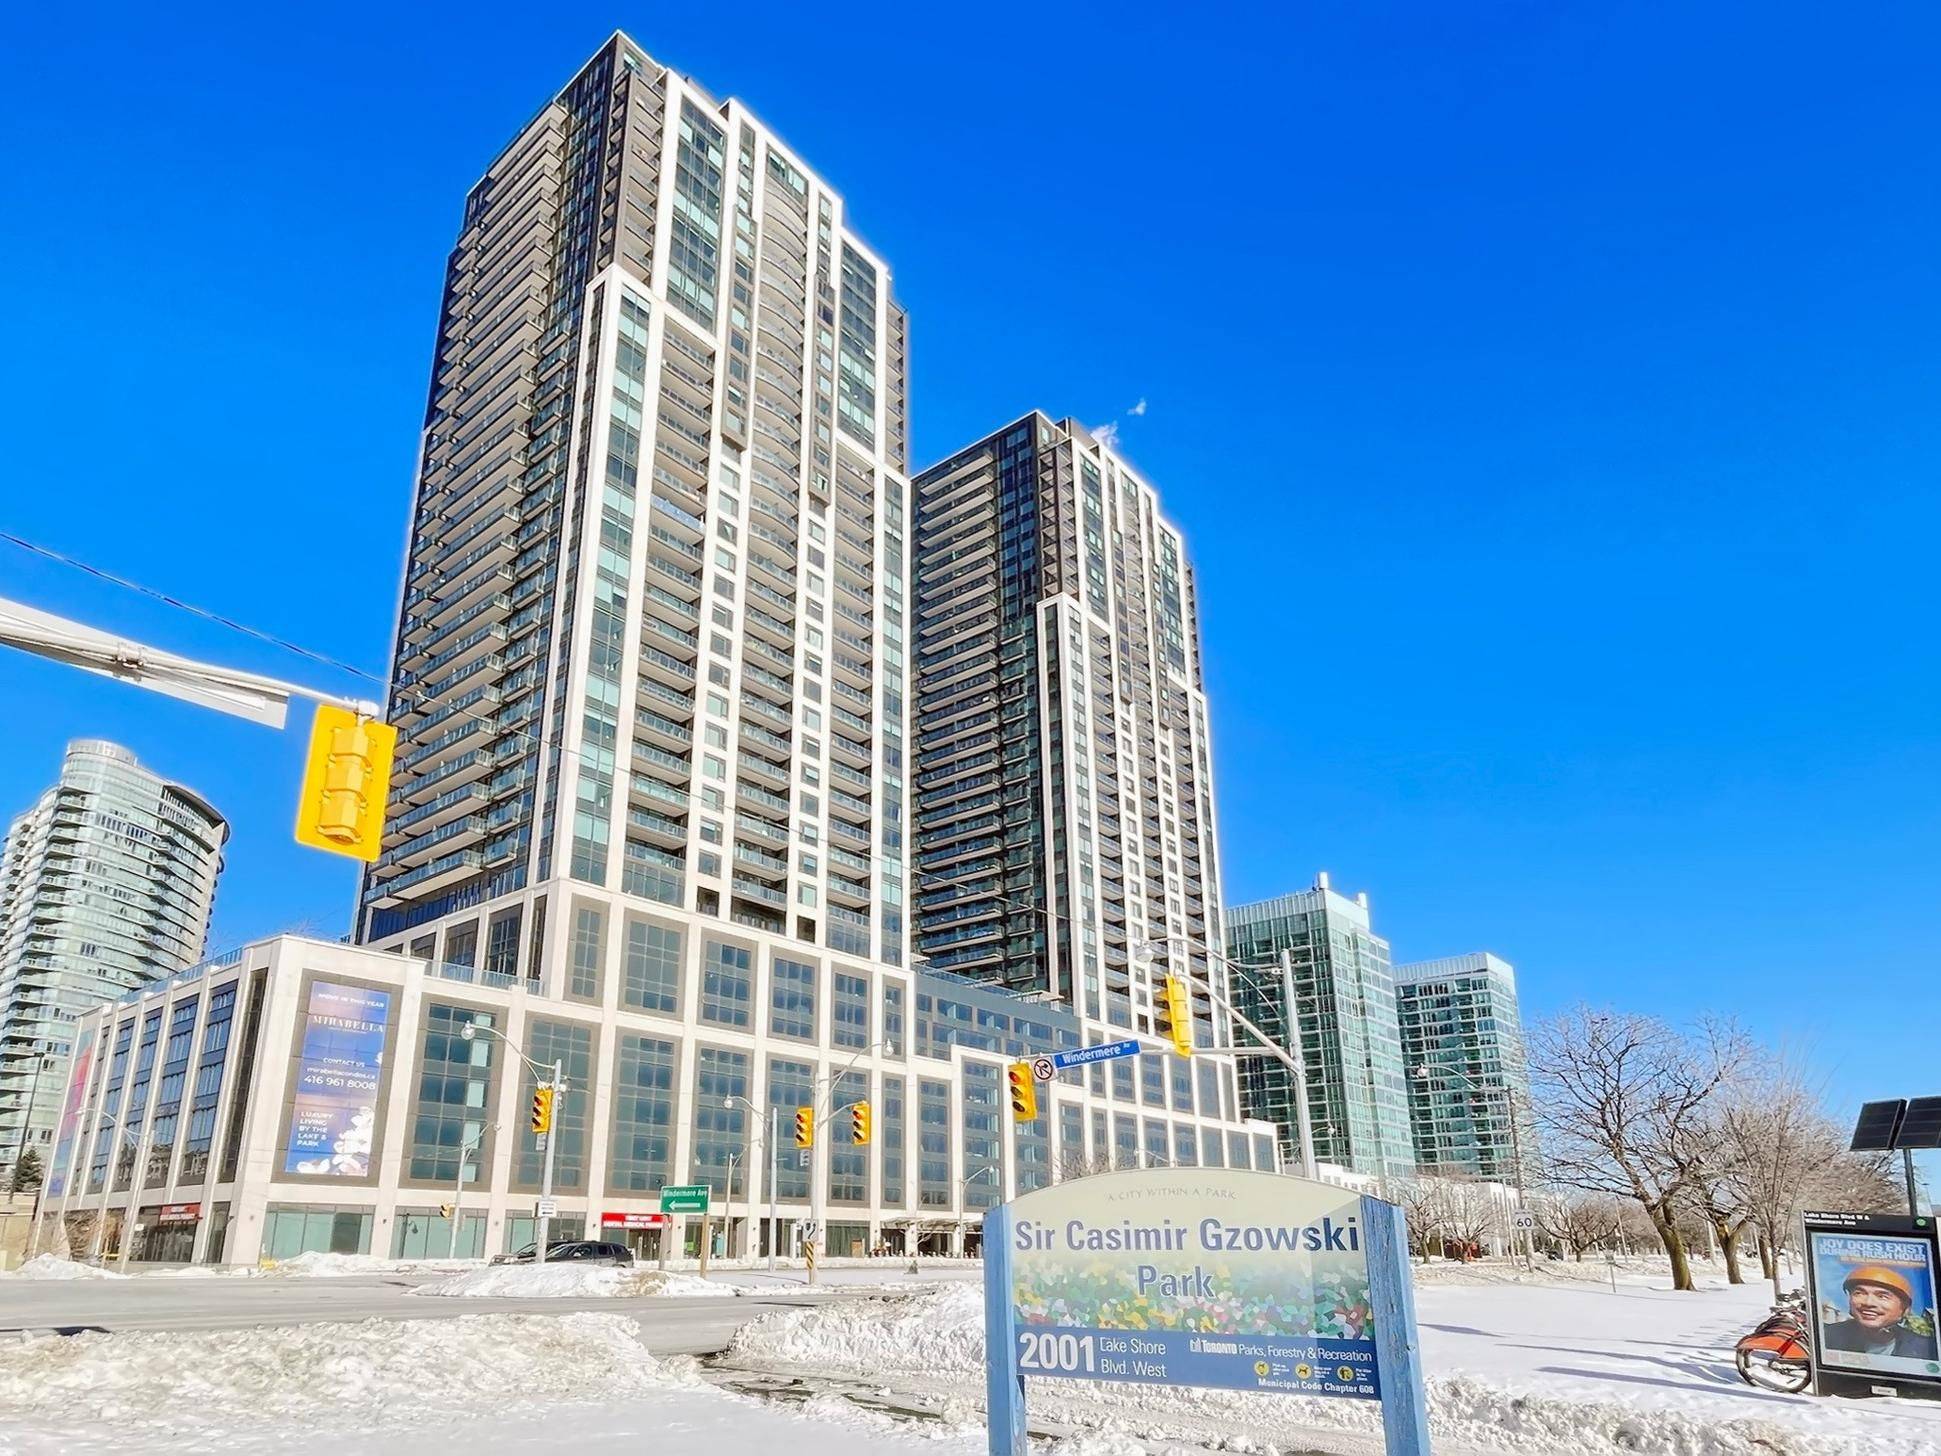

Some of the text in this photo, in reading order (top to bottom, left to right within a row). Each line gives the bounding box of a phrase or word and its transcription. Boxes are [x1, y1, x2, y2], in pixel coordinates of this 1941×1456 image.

[313, 1015, 384, 1032] MIRABELLA
[323, 1057, 354, 1066] CONTACT
[1062, 1046, 1120, 1064] Windermere
[304, 1074, 376, 1090] 416 961 8008
[1119, 1190, 1142, 1200] CITY
[1146, 1187, 1188, 1197] WITHIN
[1192, 1188, 1200, 1196] A
[1206, 1187, 1237, 1200] PARK
[1516, 1218, 1532, 1228] 60
[1015, 1216, 1360, 1252] Sir Casimir Gzowski
[1821, 1238, 1926, 1254] JOY DOES EXIST
[1820, 1248, 1860, 1257] DURING
[1863, 1250, 1892, 1260] RUSH
[1894, 1252, 1926, 1262] HOUR
[1137, 1265, 1214, 1298] Park
[1019, 1332, 1095, 1372] 2001
[1100, 1336, 1166, 1354] Lake Shore
[1268, 1345, 1306, 1360] Forestry
[1308, 1346, 1316, 1359] &
[1318, 1348, 1372, 1362] Recreation
[1102, 1358, 1168, 1378] Blvd. West
[1258, 1378, 1374, 1394] Municipal Code Chapter 608
